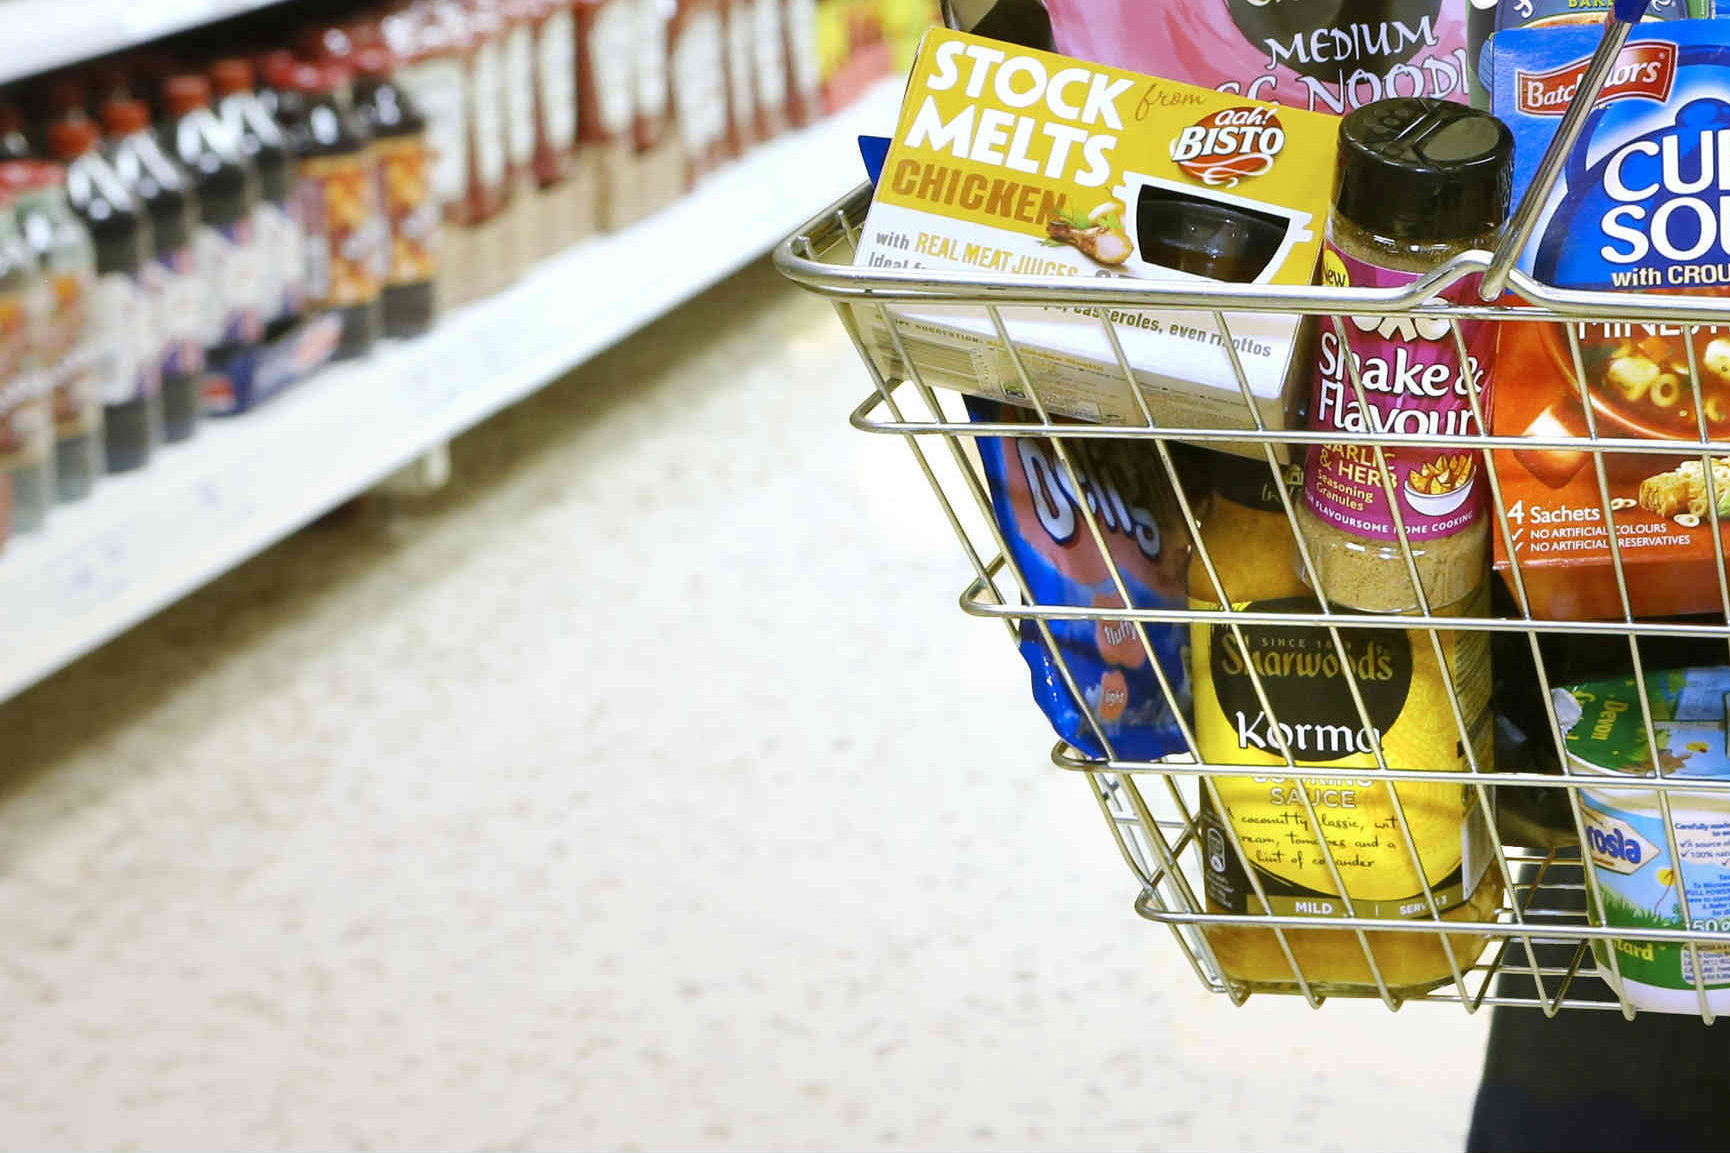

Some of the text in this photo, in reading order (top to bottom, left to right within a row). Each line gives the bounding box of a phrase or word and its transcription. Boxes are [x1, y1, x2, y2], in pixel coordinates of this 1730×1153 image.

[1265, 14, 1439, 71] MEDIUM
[926, 41, 1134, 130] STOCK
[1135, 83, 1207, 122] from
[1214, 105, 1278, 129] aah!
[904, 95, 1118, 187] MELTS
[1171, 123, 1286, 163] BISTO
[892, 157, 1068, 224] CHICKEN
[874, 229, 911, 252] with
[916, 232, 963, 264] REAL
[963, 242, 1011, 273] MEAT
[1611, 268, 1663, 288] with
[1169, 322, 1206, 345] even
[1319, 331, 1485, 398] Shake &
[1319, 377, 1475, 436] Flavour
[1316, 468, 1374, 505] Seasoning
[1318, 450, 1399, 491] & HERB
[1316, 481, 1365, 513] Granules
[1506, 499, 1601, 525] 4 Sachets
[1315, 501, 1474, 535] FLAVOURSOME COOKING
[1530, 528, 1550, 540] NO
[1551, 526, 1609, 539] ARTIFICIAL
[1530, 534, 1691, 553] NO ARTIFICIAL RESERVATIVES
[1235, 710, 1382, 754] Korma
[1271, 788, 1357, 809] SAUCE
[1320, 813, 1365, 831] lassic,
[1354, 836, 1380, 849] and
[1289, 852, 1306, 870] of
[1311, 856, 1375, 869] coander
[1294, 900, 1334, 916] MILD
